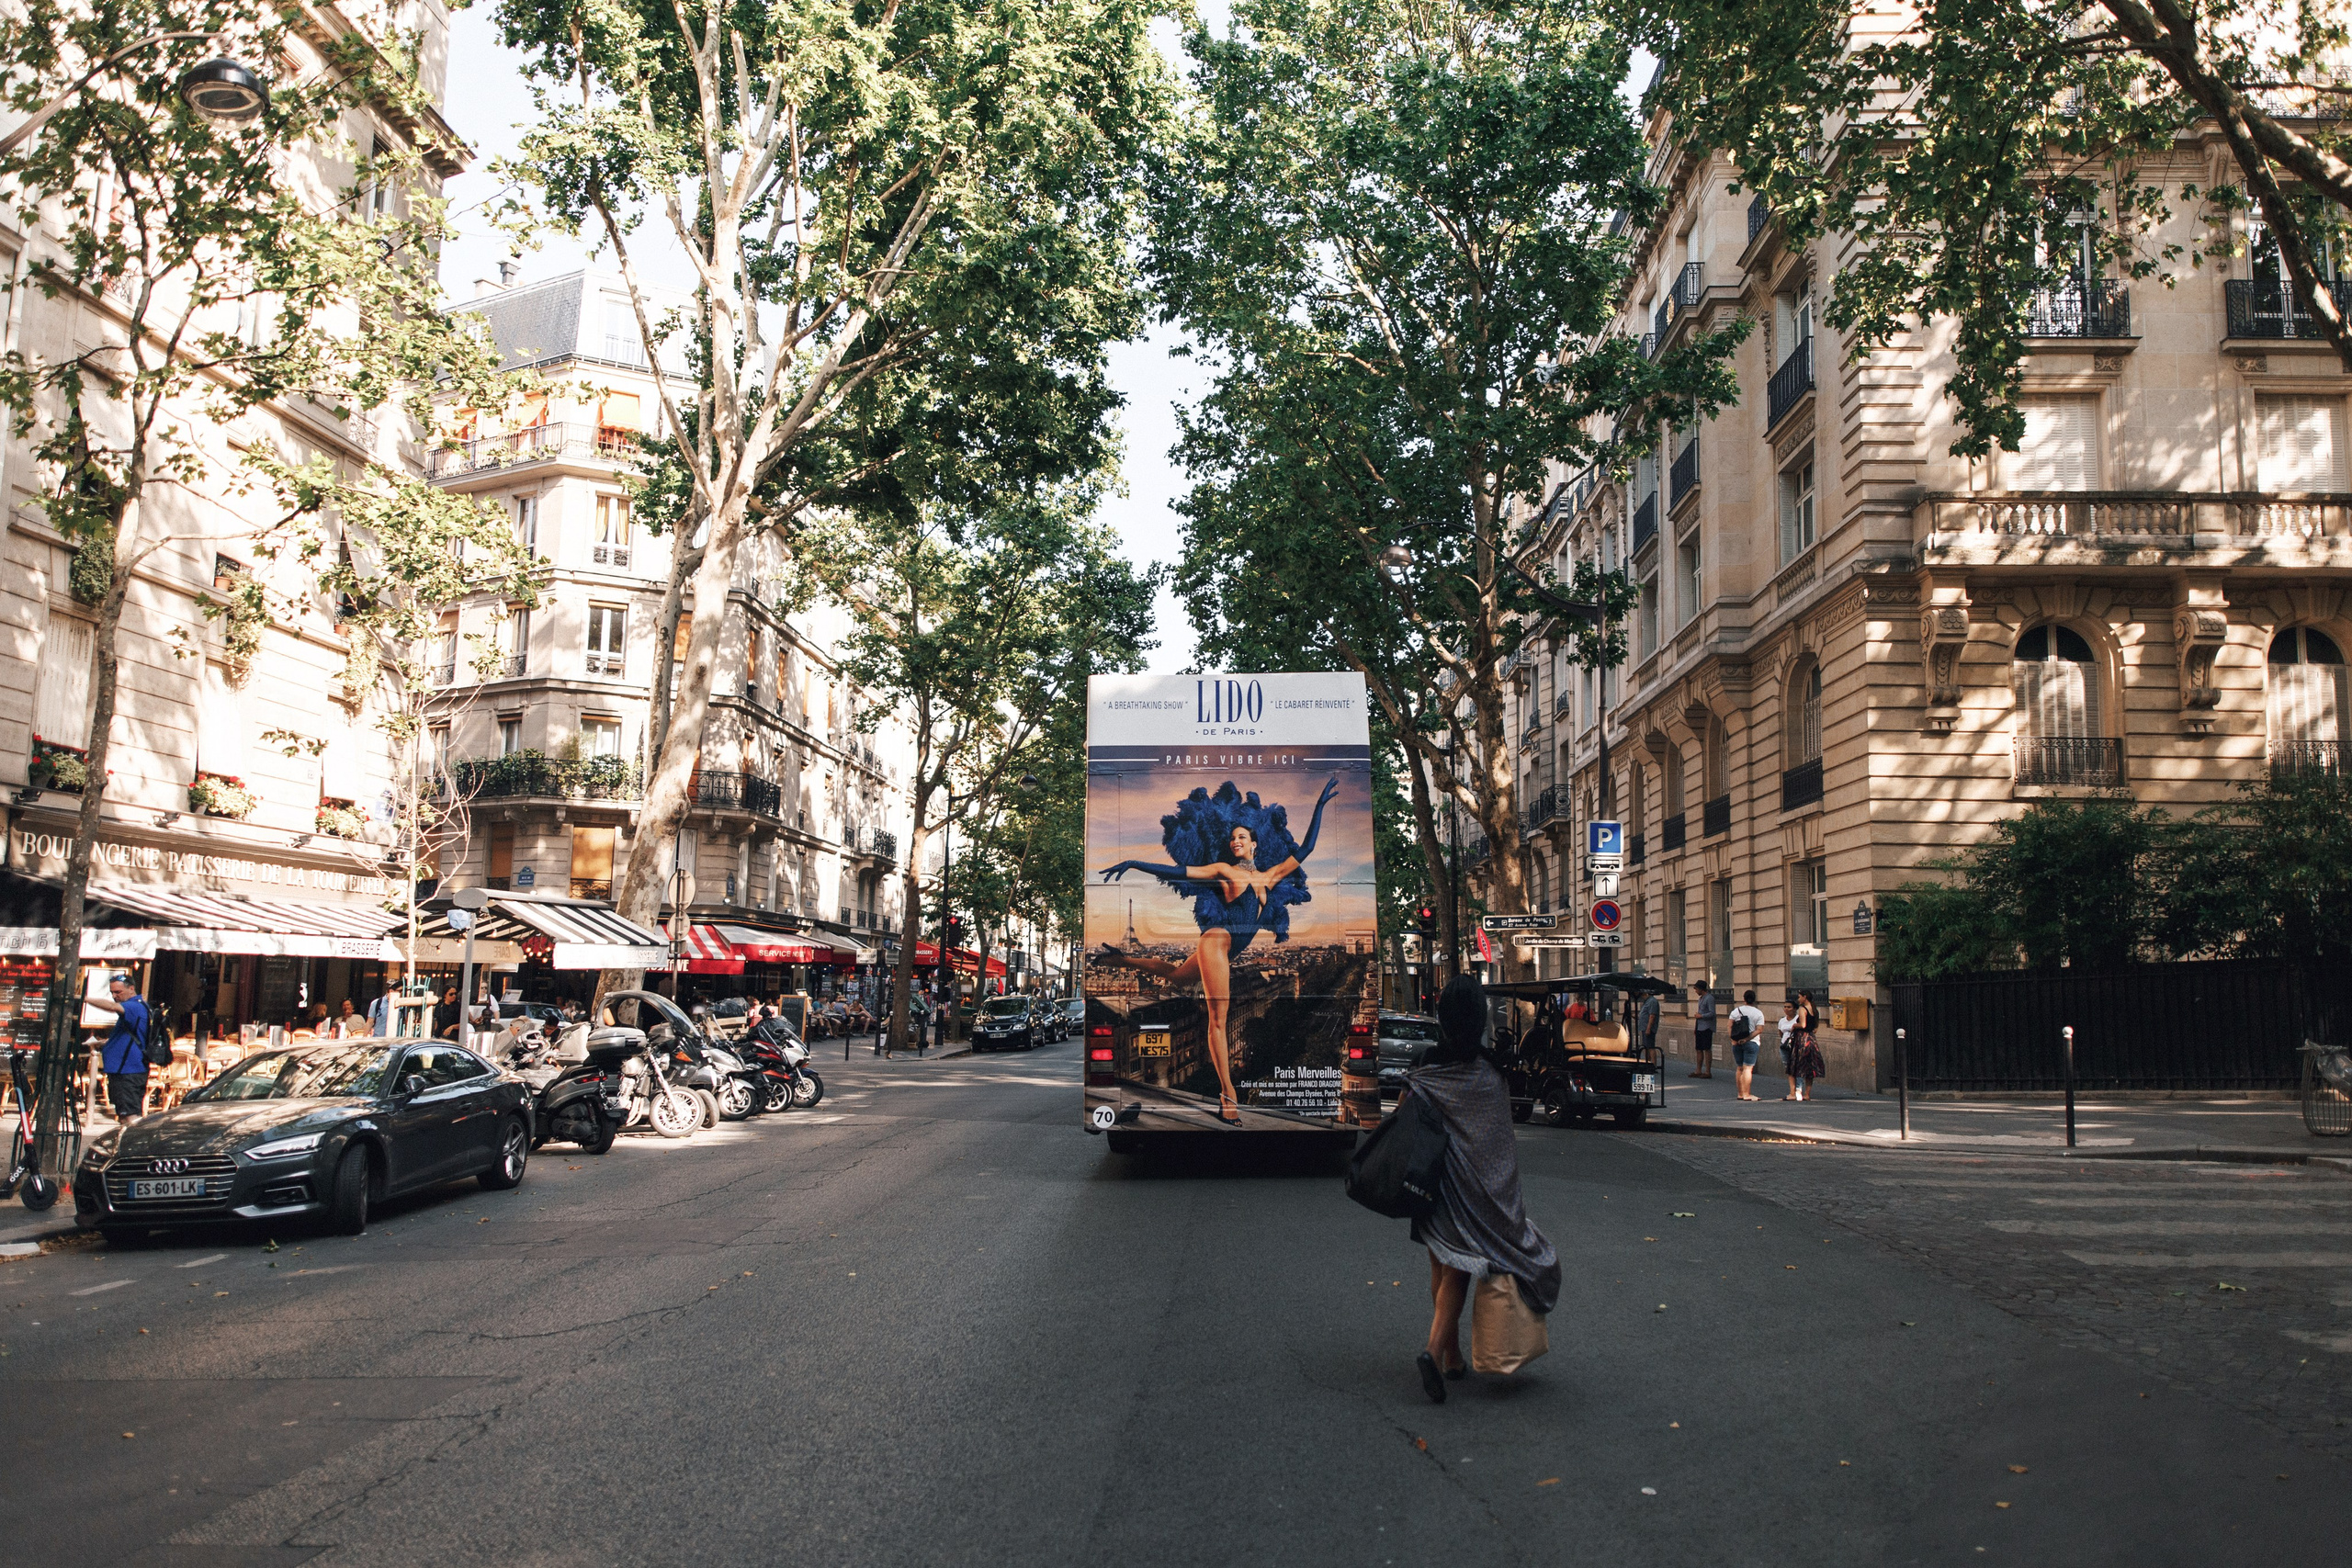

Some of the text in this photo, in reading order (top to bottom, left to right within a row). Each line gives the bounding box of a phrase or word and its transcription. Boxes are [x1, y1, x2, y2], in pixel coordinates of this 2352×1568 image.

[1114, 701, 1162, 710] BREATHTAKING
[1196, 679, 1263, 723] LIDO
[1283, 699, 1313, 709] CABARET
[1166, 755, 1295, 765] PARIS VIBRE ICI
[1598, 828, 1613, 848] P
[168, 850, 256, 882] PATISSERIE
[261, 863, 281, 885] DE
[286, 866, 306, 887] LA
[311, 869, 347, 892] TOUR
[348, 874, 389, 897] EIFFEL
[341, 942, 381, 956] BRASSERIE
[1145, 1034, 1164, 1044] 697
[1141, 1046, 1169, 1056] NES75
[1274, 1066, 1342, 1079] Paris Merveilles
[1096, 1111, 1112, 1122] 70
